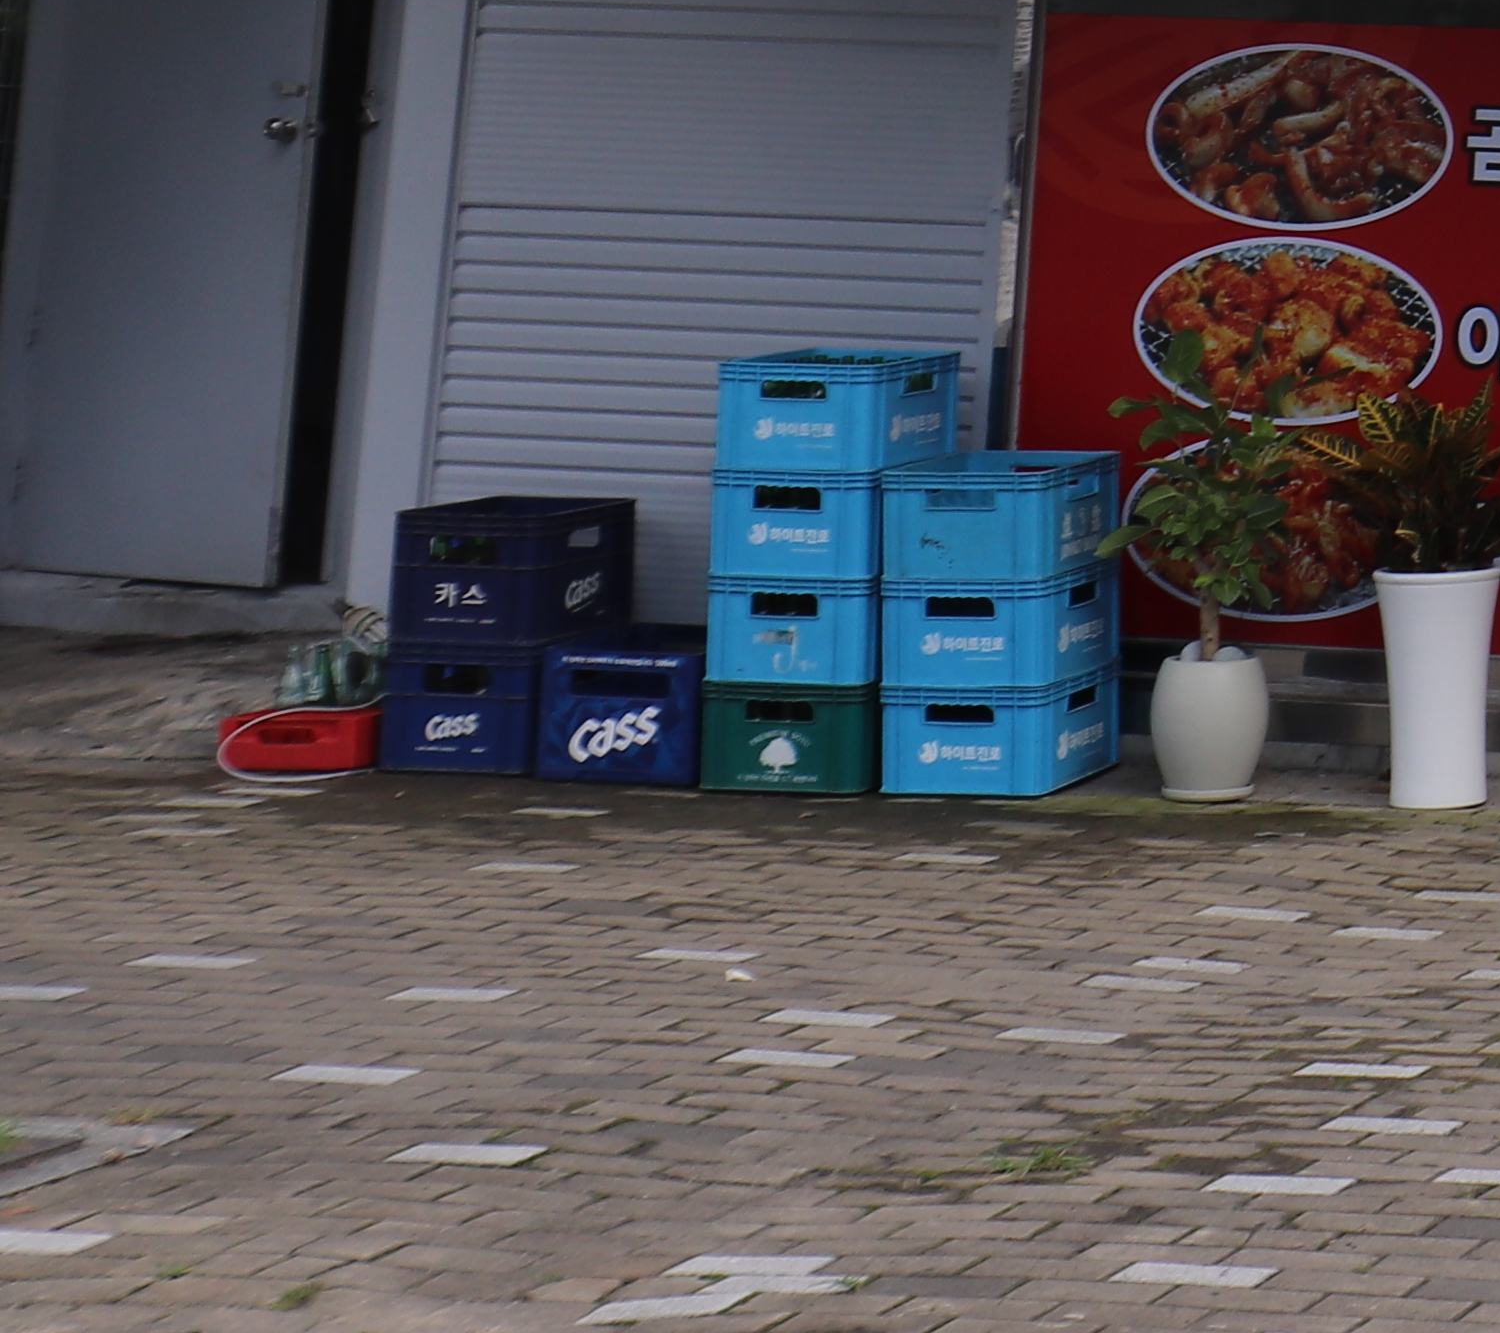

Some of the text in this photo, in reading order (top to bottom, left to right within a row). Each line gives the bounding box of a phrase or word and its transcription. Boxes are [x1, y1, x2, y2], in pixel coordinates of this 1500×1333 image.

[775, 421, 836, 438] 하이트진로
[769, 526, 830, 544] 하이트진로
[433, 581, 489, 608] 카스
[942, 633, 1005, 652] 하이트진로
[939, 741, 1002, 761] 하이트진로
